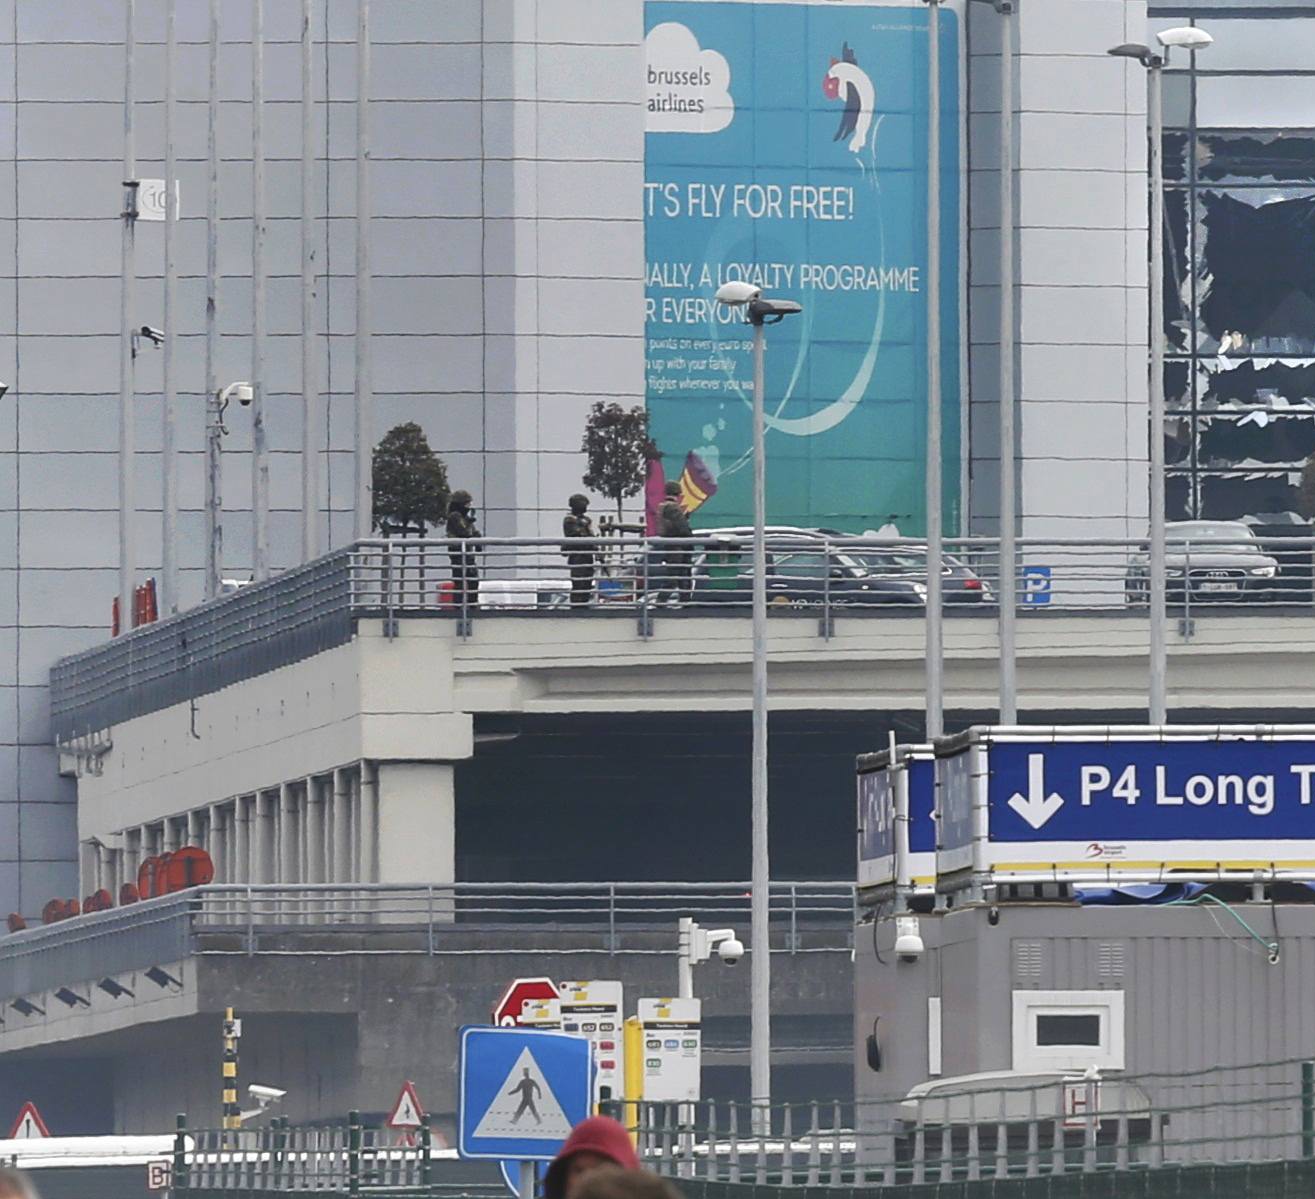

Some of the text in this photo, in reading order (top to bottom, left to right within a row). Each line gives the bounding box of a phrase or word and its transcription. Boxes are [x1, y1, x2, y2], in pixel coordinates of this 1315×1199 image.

[647, 63, 712, 86] brussels
[647, 92, 705, 114] airlines
[687, 183, 726, 218] FLY
[733, 184, 784, 219] FOR
[789, 185, 854, 220] FREE!
[698, 263, 713, 288] A
[717, 263, 795, 290] LOYALTY
[799, 263, 920, 293] PROGRAMME
[666, 355, 687, 370] with
[687, 359, 707, 374] your
[1023, 573, 1049, 603] P
[1080, 764, 1141, 806] P4
[1155, 764, 1276, 816] Long
